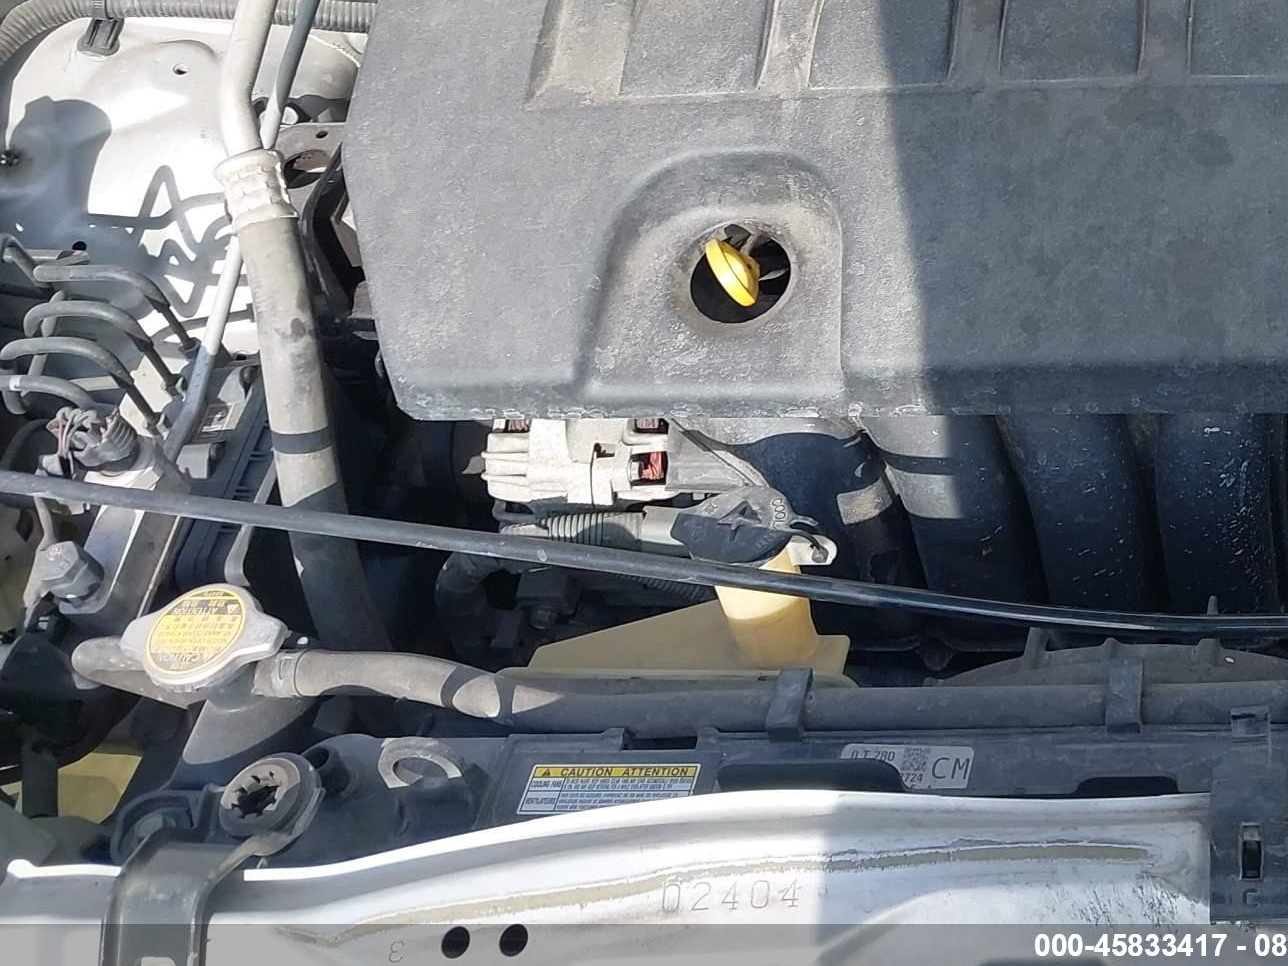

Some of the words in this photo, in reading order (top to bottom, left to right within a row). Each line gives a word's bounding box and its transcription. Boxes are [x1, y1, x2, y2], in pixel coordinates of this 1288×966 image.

[560, 767, 614, 777] CAUTION
[622, 767, 689, 777] ATTENTION
[931, 756, 971, 780] CM
[662, 878, 801, 914] 02404
